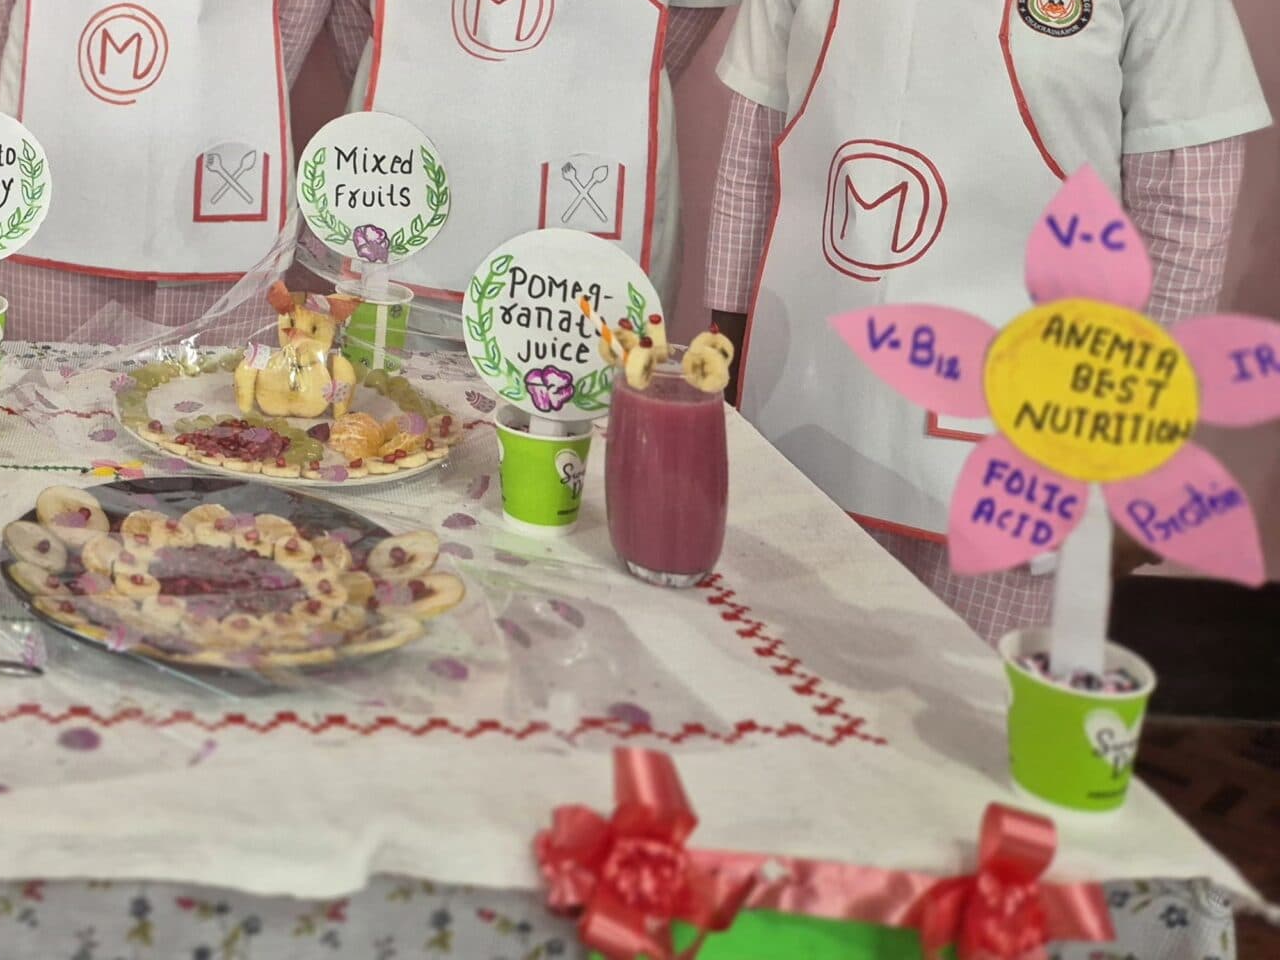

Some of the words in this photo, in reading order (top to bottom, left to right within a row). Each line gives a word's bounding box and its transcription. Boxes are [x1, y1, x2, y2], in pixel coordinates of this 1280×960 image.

[334, 146, 414, 175] Mixed
[1041, 314, 1179, 378] ANEMIA
[1070, 362, 1169, 411] BEST
[1014, 401, 1195, 446] NUTRITION
[982, 459, 1080, 521] FOLIC
[971, 498, 1055, 547] ACID
